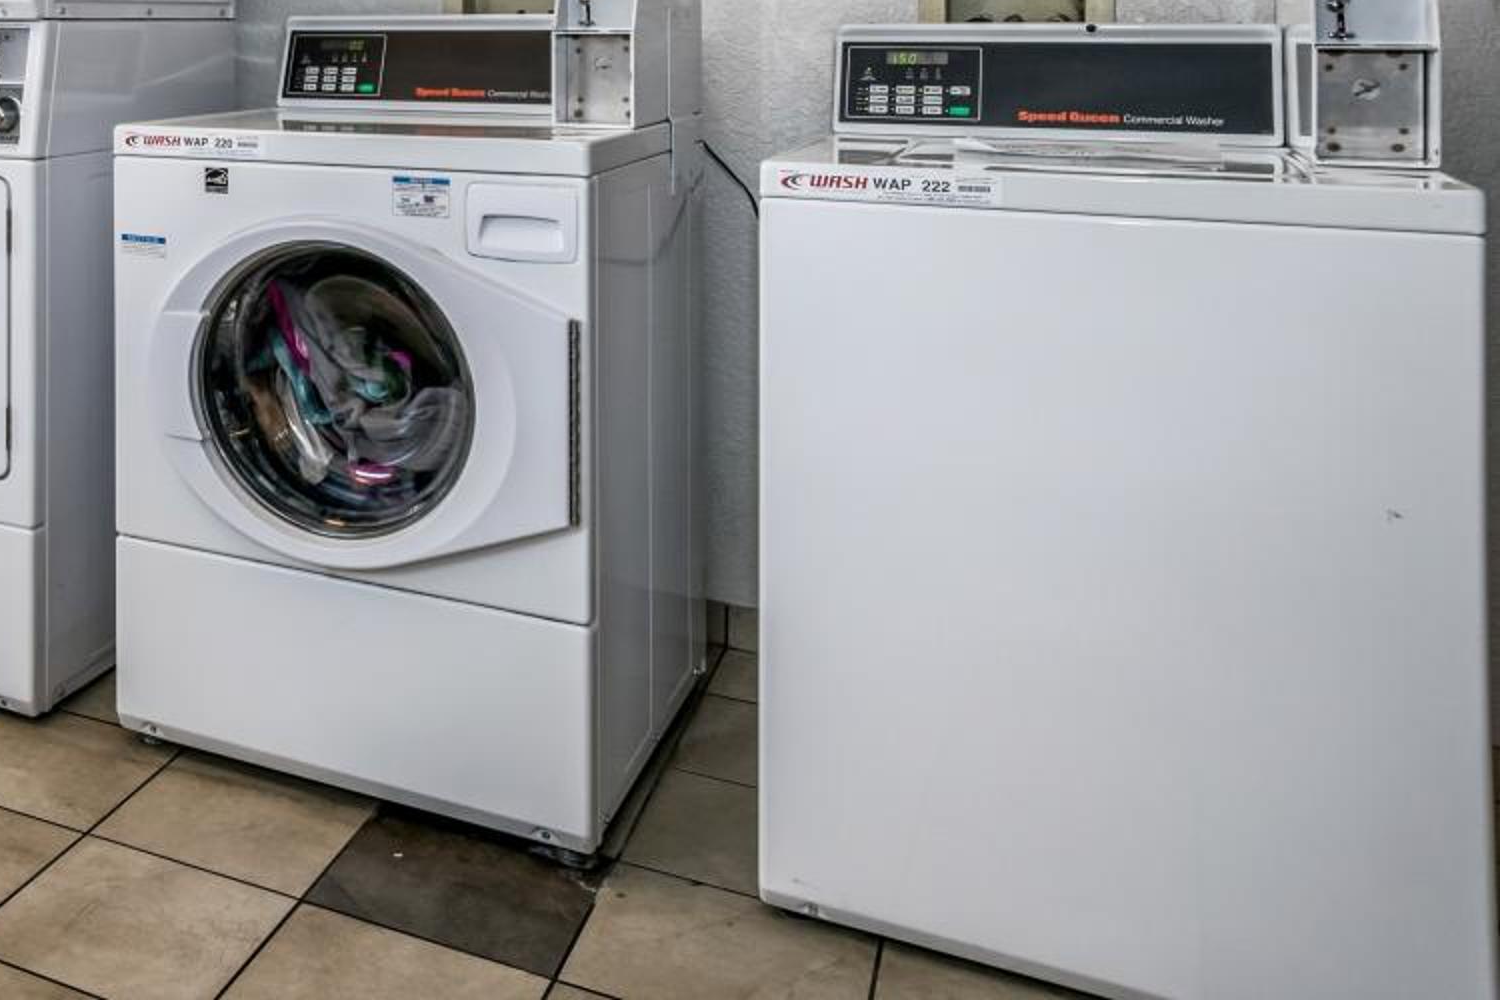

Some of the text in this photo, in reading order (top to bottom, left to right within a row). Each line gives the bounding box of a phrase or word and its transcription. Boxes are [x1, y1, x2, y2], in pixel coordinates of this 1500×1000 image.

[1018, 110, 1225, 126] Speed Queen Commercial Washer
[143, 135, 233, 149] WASH WAP 220
[809, 174, 951, 193] WASH WAP 222
